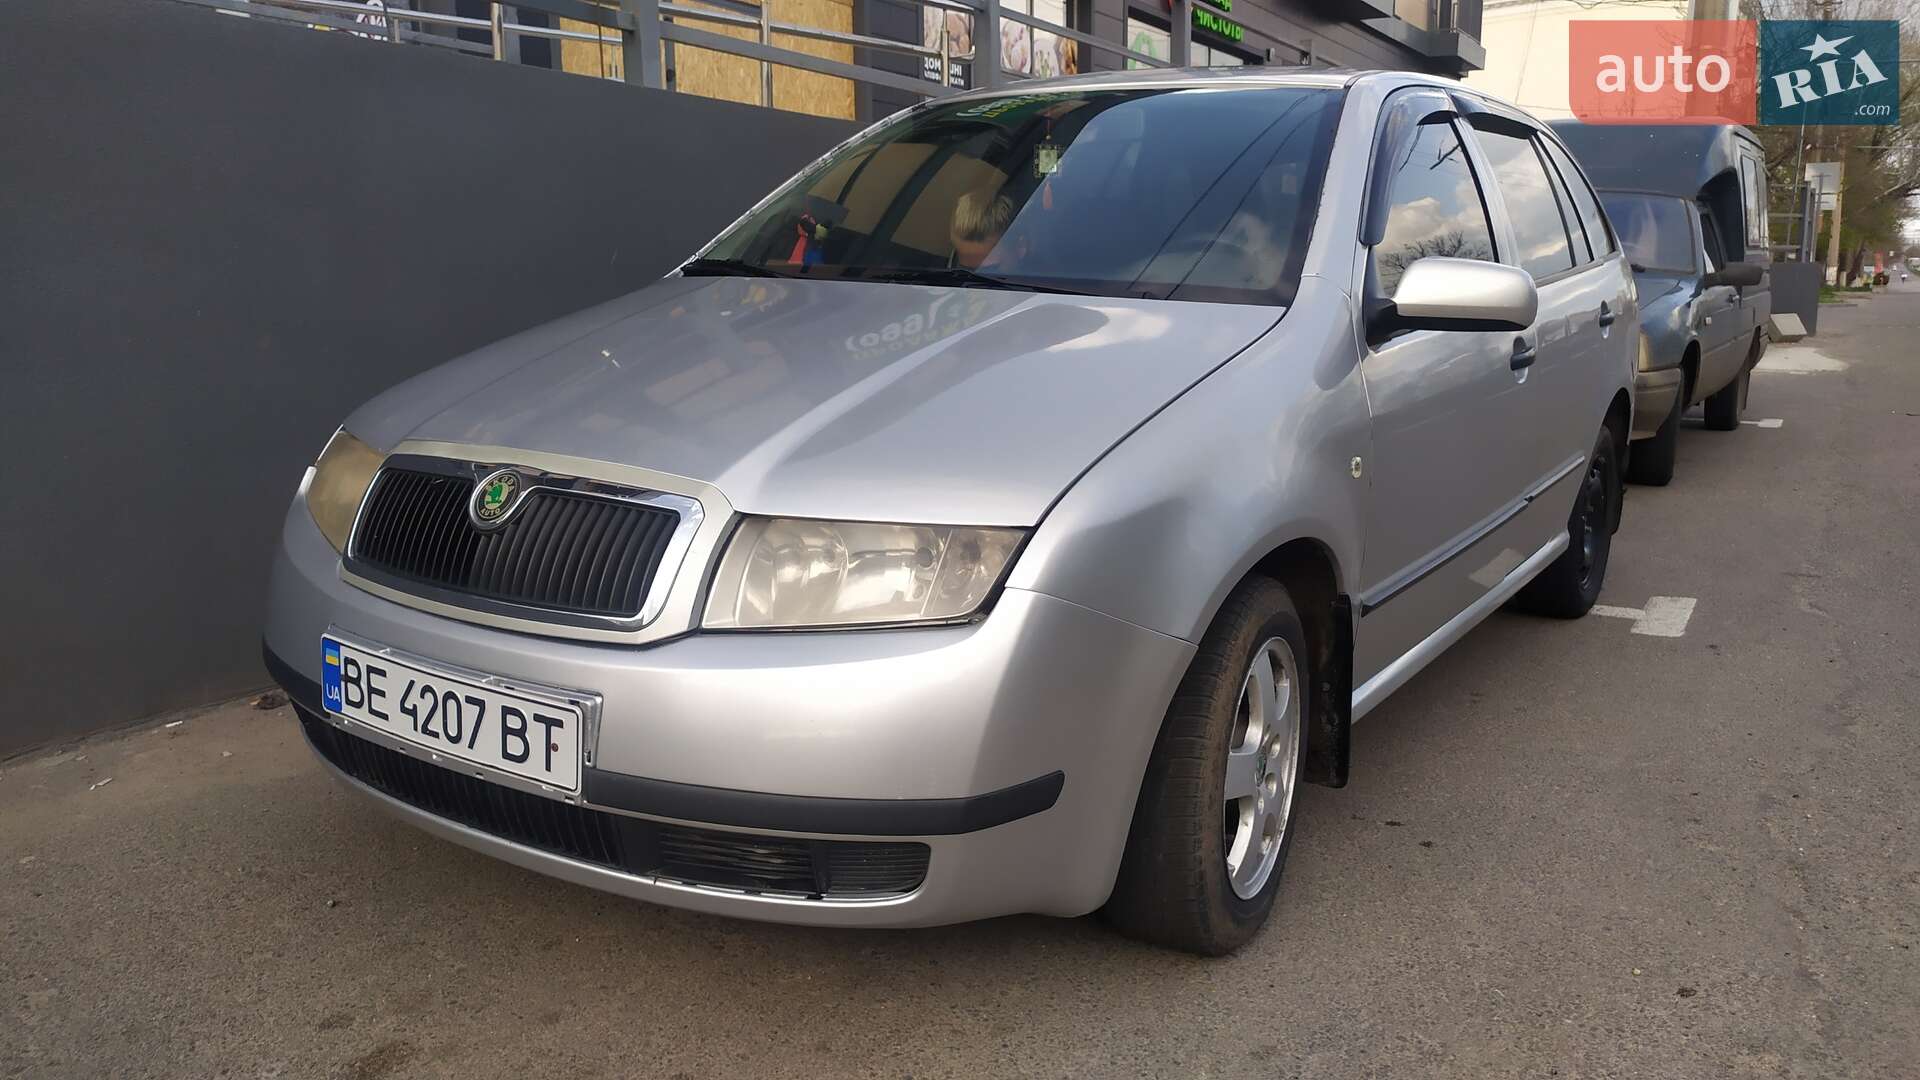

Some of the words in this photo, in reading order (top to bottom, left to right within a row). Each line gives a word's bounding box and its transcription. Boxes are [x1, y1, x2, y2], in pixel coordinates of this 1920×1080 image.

[326, 683, 341, 702] UA
[343, 656, 389, 721] BE
[400, 680, 486, 750] 4207
[501, 705, 564, 773] BT
